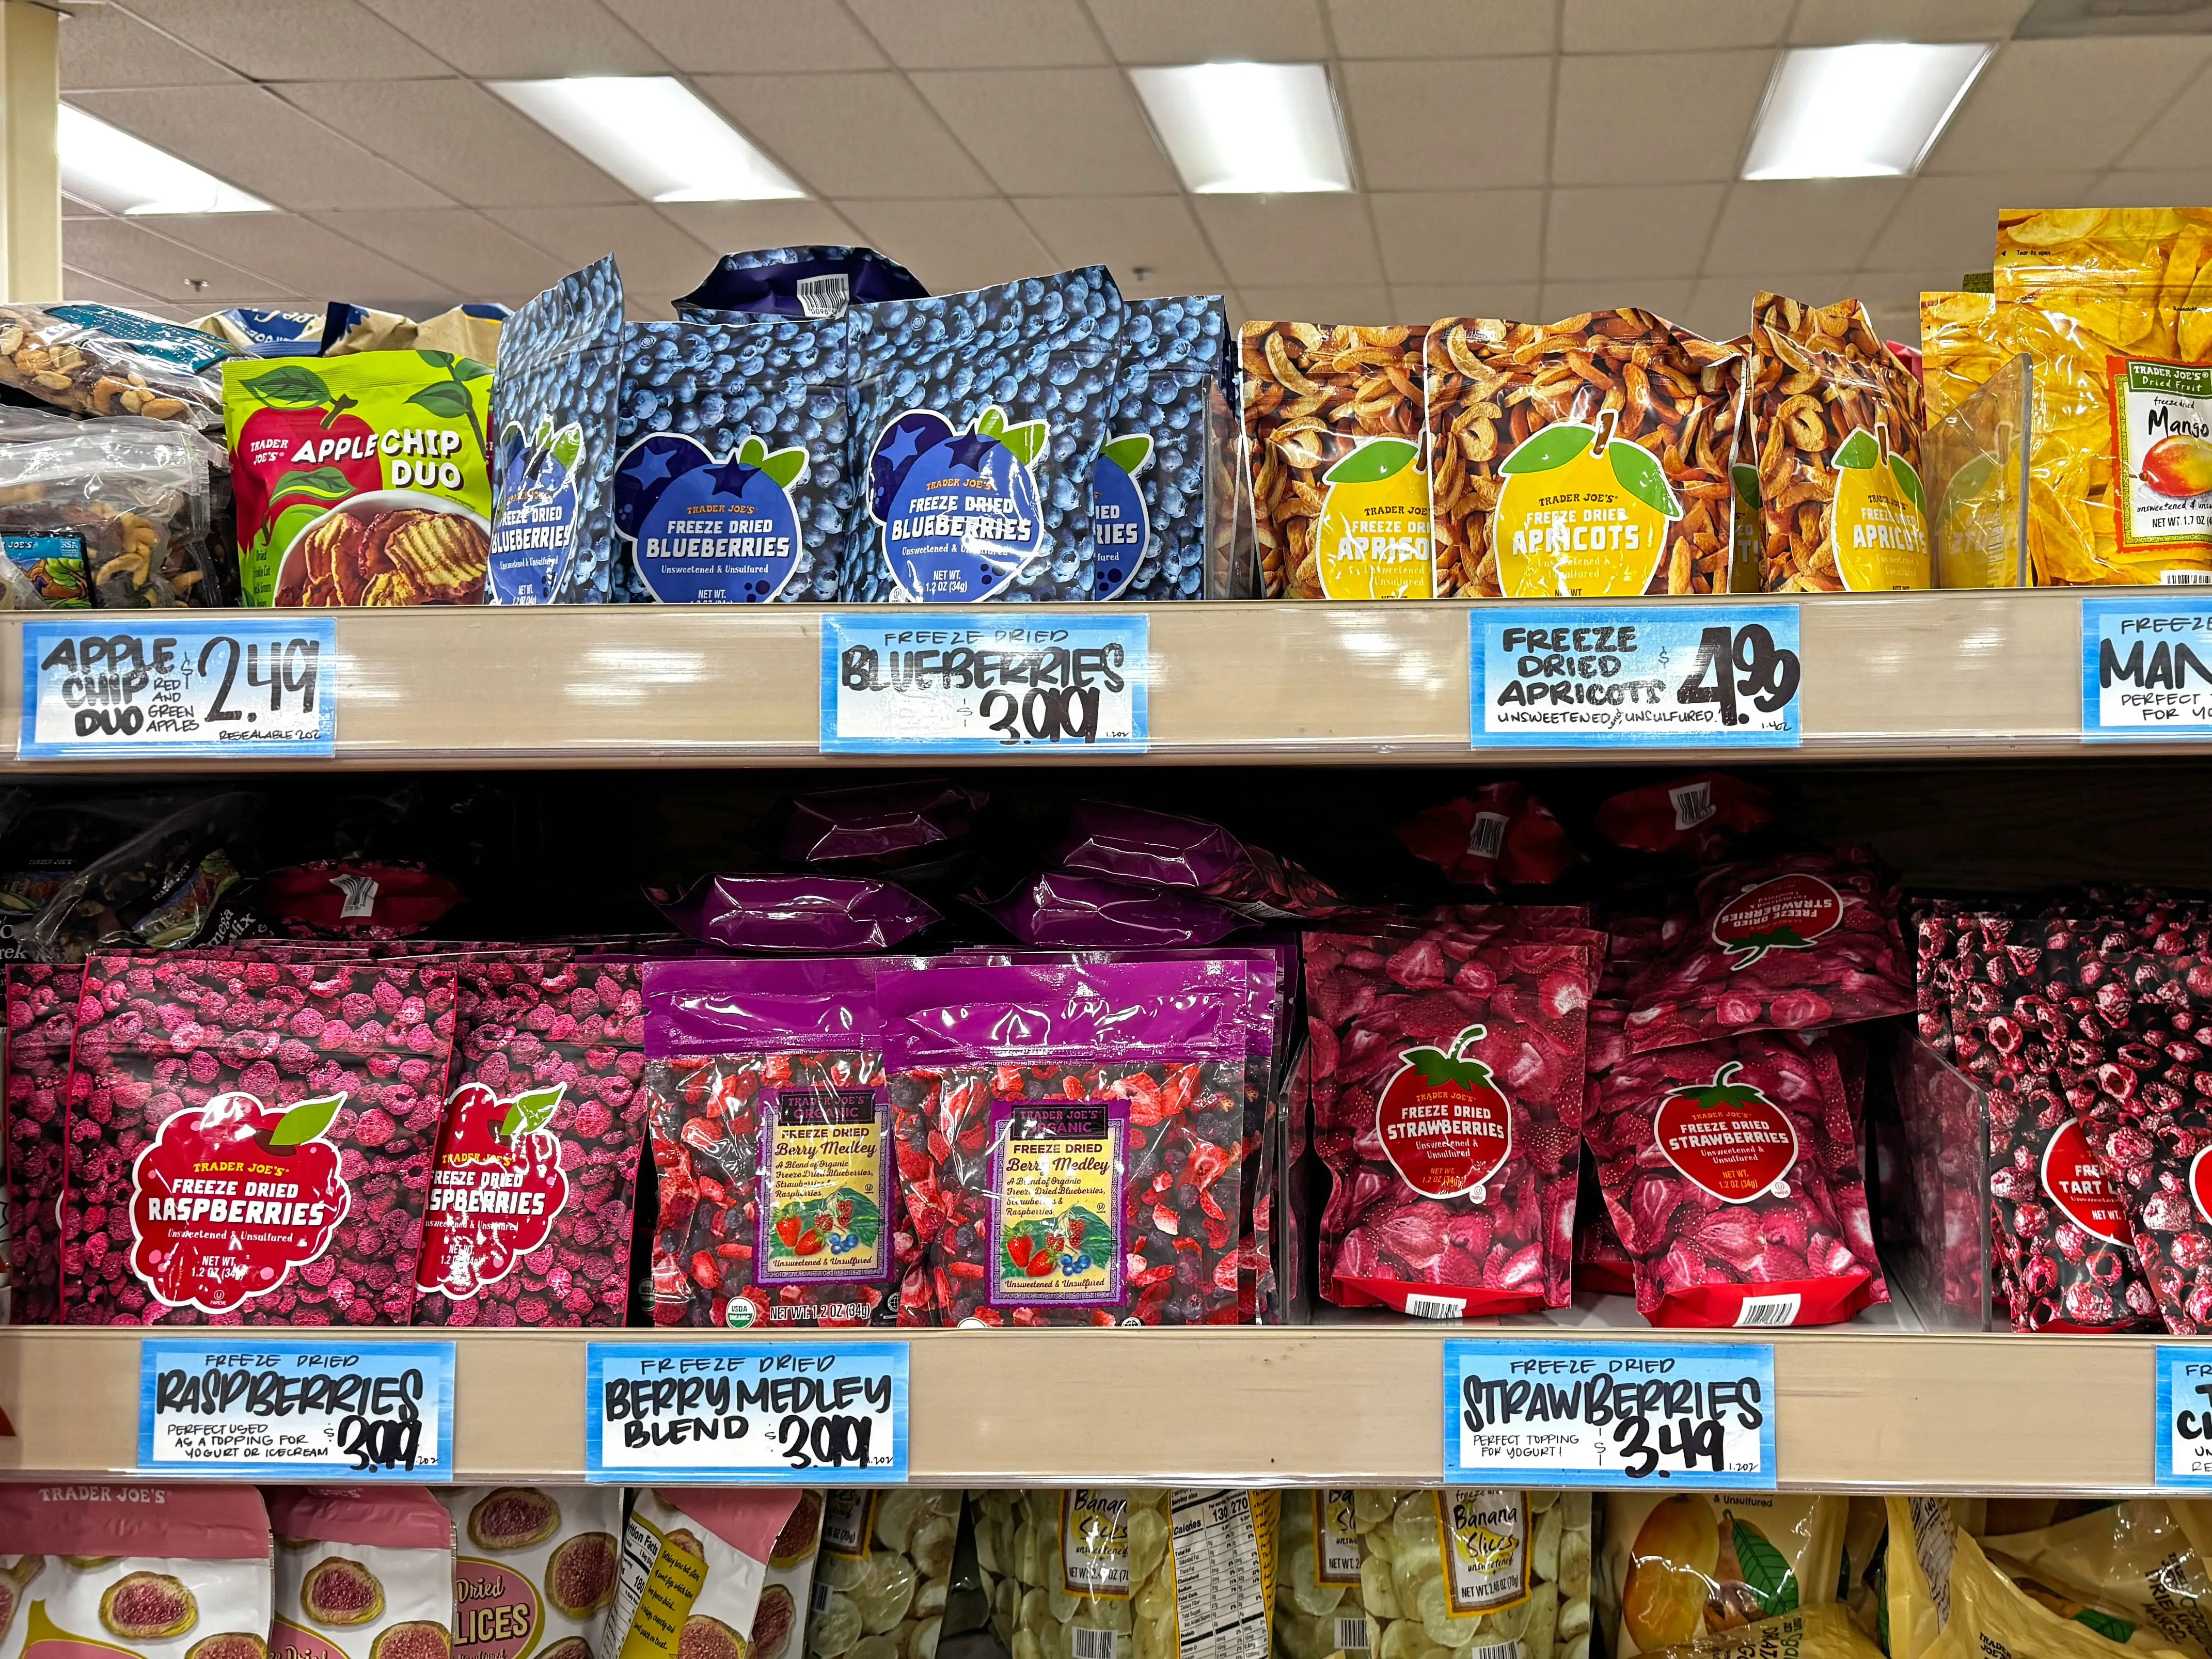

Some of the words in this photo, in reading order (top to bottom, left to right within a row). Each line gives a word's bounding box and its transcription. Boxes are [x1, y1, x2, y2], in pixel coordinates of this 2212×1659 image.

[2134, 366, 2171, 378] TRADER
[2142, 376, 2171, 388] Dried
[2175, 381, 2203, 392] Fruit
[2154, 397, 2177, 407] freeze
[2148, 405, 2209, 438] Mango
[250, 439, 288, 452] TRADER
[291, 433, 379, 463] APPLE
[380, 429, 461, 456] CHIP
[391, 459, 463, 488] DUO
[927, 478, 960, 491] TRADER
[909, 496, 958, 514] FREEZE
[965, 496, 1014, 514] DRIED
[1539, 494, 1581, 507] TRADER
[2137, 500, 2187, 513] unsweetened
[532, 505, 562, 523] DRIED
[687, 505, 725, 514] TRADER
[1364, 505, 1405, 516] TRADER
[1526, 510, 1576, 525] FREEZE
[1583, 508, 1627, 522] DRIED
[667, 520, 723, 534] FREEZE
[729, 519, 773, 533] DRIED
[1351, 520, 1402, 534] FREEZE
[2152, 518, 2166, 528] NET
[2196, 516, 2205, 525] OZ
[892, 518, 1032, 542] BLUEBERRIES
[491, 525, 571, 554] BLUEBERRIES
[1512, 525, 1639, 556] APRICOTS
[1853, 525, 1927, 555] APRICOTS
[646, 537, 791, 558] BLUEBERRIES
[902, 543, 949, 556] Unsweetened
[661, 565, 714, 574] Unsweetened
[725, 564, 768, 574] Unsulfured
[933, 570, 947, 581] NET
[948, 570, 961, 581] WT.
[938, 581, 947, 592] OZ
[884, 630, 982, 646] FREEZE
[994, 629, 1069, 645] DRIED
[1503, 625, 1638, 654] FREEZE
[41, 634, 177, 675] APPLE
[842, 642, 1125, 693] BLUEBERRIES
[1518, 653, 1622, 679] DRIED
[61, 672, 149, 709] CHIP
[154, 677, 180, 690] RED
[151, 691, 181, 703] AND
[1497, 678, 1667, 706] APRICOTS
[2121, 692, 2201, 706] PERFECT
[149, 704, 194, 718] GREEN
[2142, 708, 2179, 721] FOR
[75, 704, 145, 737] DUO
[146, 719, 200, 733] APPLES
[219, 729, 293, 741] RESEALABLE
[1721, 898, 1832, 924] STRAWBERRIES
[788, 1096, 831, 1107] TRADER
[1416, 1091, 1448, 1102] TRADER
[794, 1107, 859, 1119] ORGANIC
[1021, 1110, 1063, 1120] TRADER
[1401, 1104, 1449, 1119] FREEZE
[1453, 1105, 1491, 1119] DRIED
[1692, 1112, 1724, 1120] TRADER
[781, 1129, 828, 1139] FREEZE
[832, 1128, 870, 1137] DRIED
[1387, 1120, 1505, 1140] STRAWBERRIES
[1680, 1121, 1728, 1134] FREEZE
[1733, 1120, 1770, 1130] DRIED
[1013, 1144, 1062, 1154] FREEZE
[1065, 1143, 1103, 1154] DRIED
[1415, 1139, 1470, 1150] Unsweetened
[1669, 1132, 1790, 1151] STRAWBERRIES
[775, 1142, 819, 1160] Berry
[820, 1140, 877, 1158] Medley
[1427, 1148, 1471, 1159] Unsulfured
[1701, 1145, 1756, 1157] Unsweetened
[441, 1153, 480, 1163] TRADER
[1713, 1154, 1759, 1164] Unsulfured
[193, 1162, 244, 1173] TRADER
[818, 1160, 849, 1171] Organic
[1052, 1157, 1111, 1176] Medley
[172, 1178, 239, 1195] FREEZE
[245, 1182, 298, 1198] DRIED
[480, 1173, 524, 1190] DRIED
[1050, 1177, 1081, 1188] Organic
[2059, 1181, 2102, 1195] TART
[1034, 1187, 1057, 1195] Dried
[148, 1197, 325, 1226] RASPBERRIES
[1006, 1208, 1054, 1217] Raspberries
[2092, 1210, 2106, 1221] NET
[2107, 1210, 2121, 1220] WT.
[167, 1228, 227, 1240] Unsweetened
[241, 1231, 293, 1243] Unsulfured
[773, 1258, 821, 1267] Unsweetened
[830, 1256, 872, 1267] Unsulfured
[1005, 1279, 1053, 1288] Unsweetened
[1062, 1278, 1105, 1289] Unsulfured
[770, 1306, 788, 1320] NET
[789, 1305, 809, 1320] WT.
[829, 1304, 843, 1318] OZ
[845, 1304, 871, 1321] (34g)
[205, 1354, 281, 1368] FREEZE
[296, 1354, 359, 1367] DRIED
[640, 1357, 746, 1375] FREEZE
[759, 1354, 836, 1373] DRIED
[1509, 1358, 1597, 1374] FREEZE
[1608, 1358, 1676, 1373] DRIED
[156, 1368, 423, 1423] RASPBERRIES
[605, 1376, 731, 1421] BERRY
[736, 1374, 892, 1414] MEDLEY
[1463, 1372, 1763, 1432] STRAWBERRIES
[168, 1424, 229, 1436] PERFECT
[230, 1424, 268, 1435] USED
[624, 1415, 749, 1448] BLEND
[175, 1436, 195, 1447] AS
[197, 1436, 207, 1446] A
[212, 1435, 273, 1447] TOPPING
[279, 1434, 309, 1445] FOR
[1473, 1435, 1519, 1446] PERFECT
[1526, 1435, 1579, 1447] TOPPING
[184, 1447, 240, 1459] YOGURT
[243, 1447, 261, 1457] OR
[1481, 1447, 1507, 1457] FOR
[38, 1487, 113, 1503] TRADER
[1724, 1496, 1773, 1508] Unsulfured
[1212, 1509, 1228, 1522] 130
[1230, 1496, 1249, 1514] 270
[1453, 1504, 1518, 1530] Banana
[1173, 1519, 1202, 1536] Calories
[1466, 1531, 1514, 1558] Slices
[456, 1574, 505, 1602] Dried
[1461, 1586, 1475, 1599] NET
[1475, 1583, 1489, 1596] WT.
